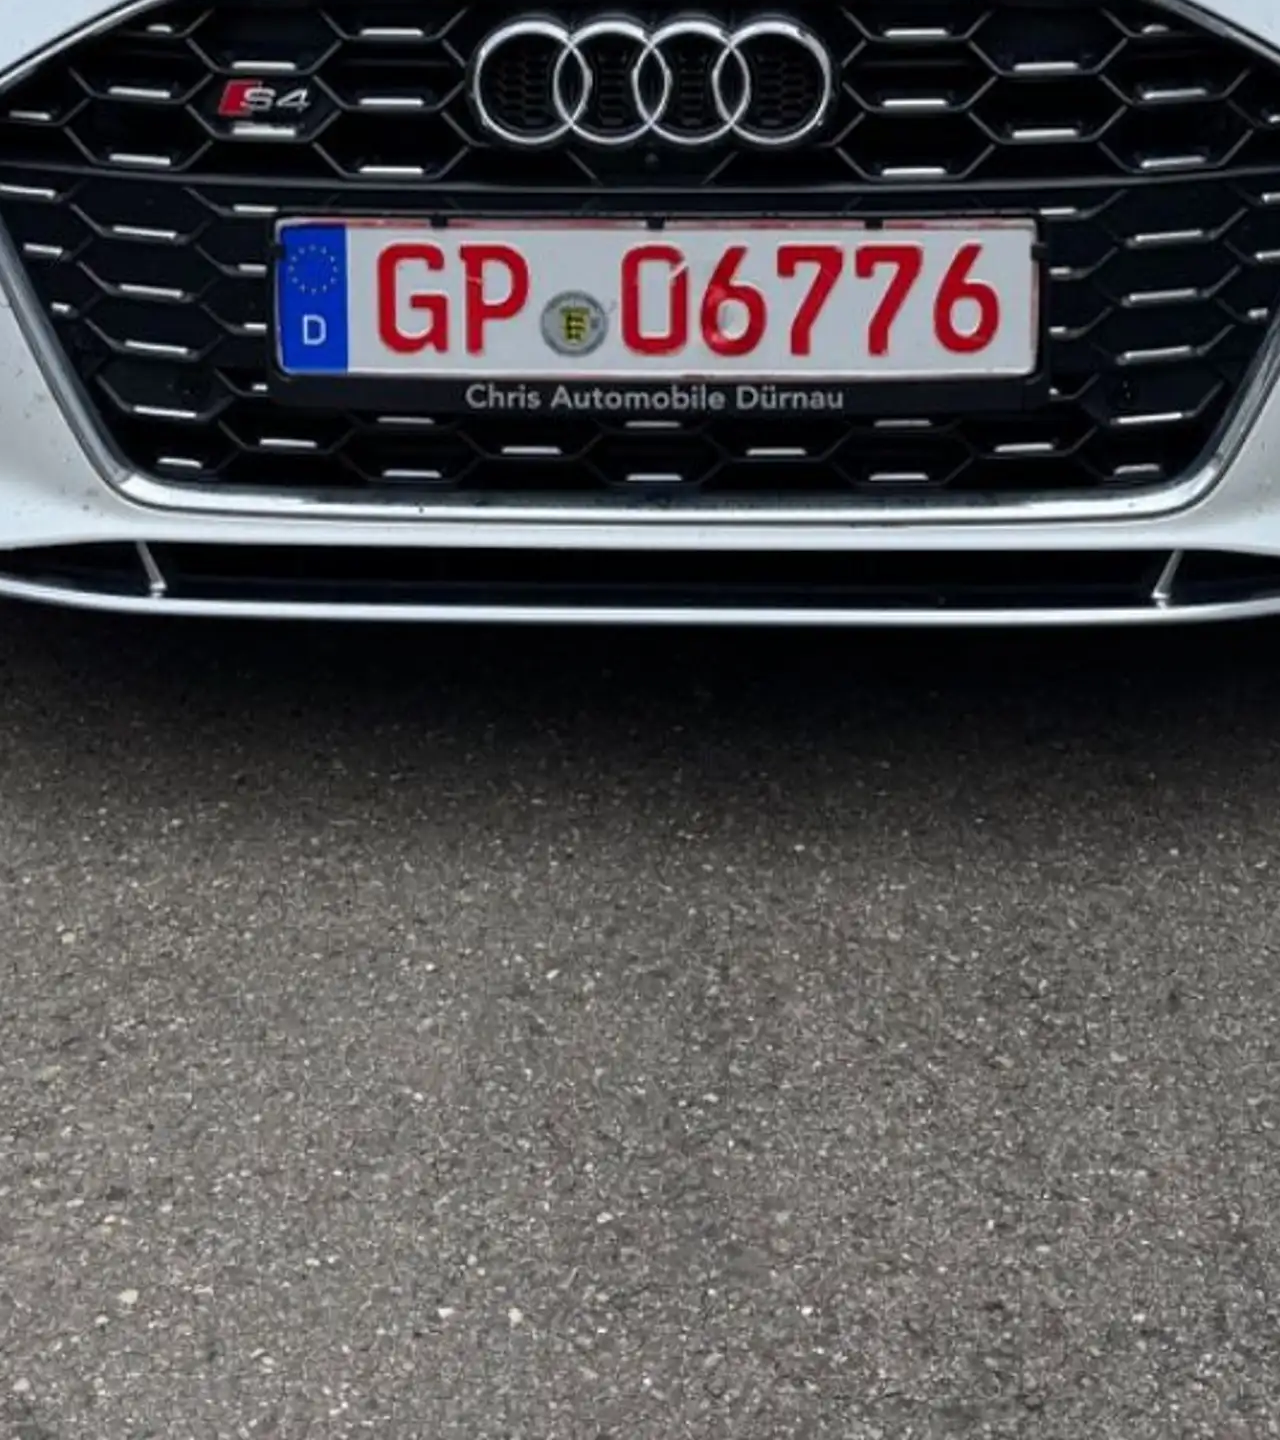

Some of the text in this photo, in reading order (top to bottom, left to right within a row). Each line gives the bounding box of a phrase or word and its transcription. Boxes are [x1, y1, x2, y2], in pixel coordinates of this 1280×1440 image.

[242, 87, 310, 113] S4
[377, 243, 1000, 357] GP 06776
[303, 315, 327, 345] D
[465, 383, 843, 410] Chris Automobile Dürnau
